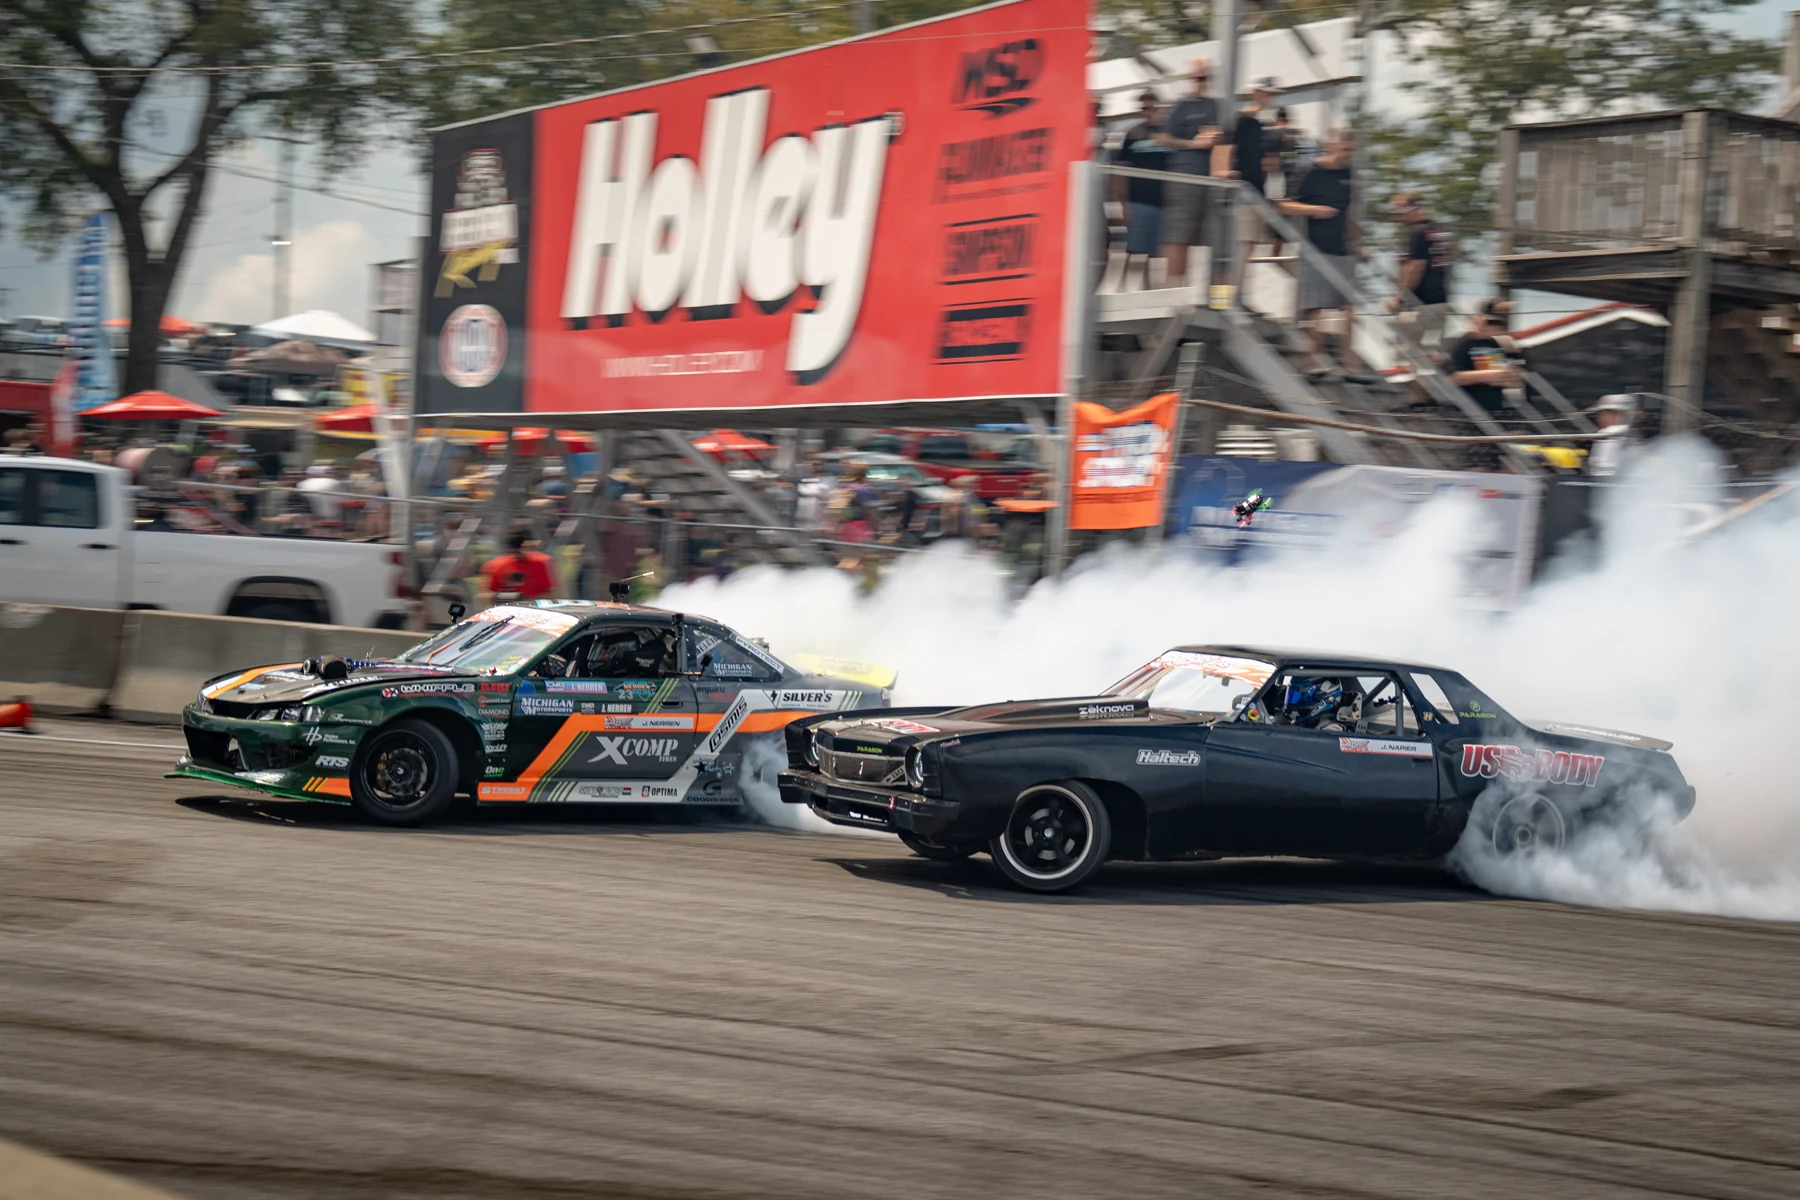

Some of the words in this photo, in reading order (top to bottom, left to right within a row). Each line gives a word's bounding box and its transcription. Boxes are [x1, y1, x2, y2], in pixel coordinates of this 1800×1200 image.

[560, 86, 892, 386] Holley
[735, 636, 783, 671] PYROTECT
[713, 662, 752, 670] MICHIGAN
[577, 683, 603, 692] NERREN
[696, 685, 726, 694] enjuku
[618, 689, 634, 699] 23
[782, 690, 834, 703] SILVER'S
[521, 697, 575, 708] MICHIGAN
[522, 706, 574, 716] MOTORSPORTS
[601, 704, 606, 713] J.
[607, 704, 632, 713] NERREN
[1459, 711, 1497, 719] PARAGON
[708, 695, 748, 752] COSMIS
[1388, 744, 1417, 752] NAPIER
[315, 755, 350, 768] RTS
[1137, 750, 1200, 766] Haltech
[1460, 744, 1501, 779] US
[1530, 749, 1604, 787] BODY
[651, 787, 678, 797] OPTIMA
